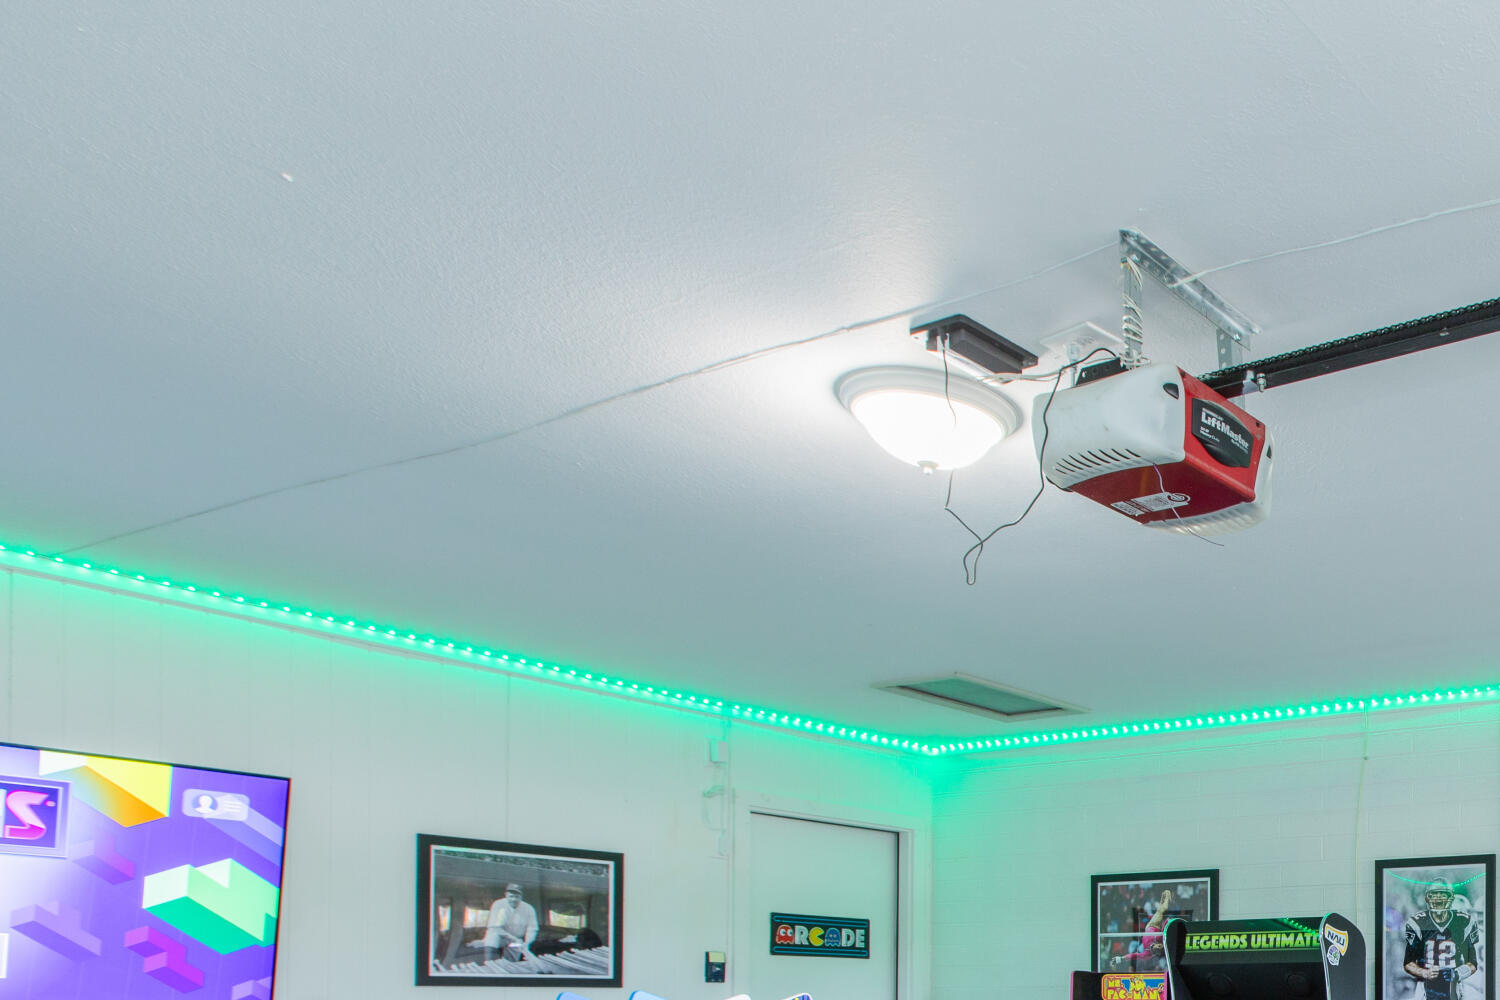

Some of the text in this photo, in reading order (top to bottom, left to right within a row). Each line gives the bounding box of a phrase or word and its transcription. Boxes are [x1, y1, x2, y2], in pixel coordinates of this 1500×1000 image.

[1201, 411, 1249, 450] LiftMaster
[776, 924, 865, 948] ARCADE
[1186, 934, 1248, 950] LEGENDS
[1425, 940, 1457, 969] 12
